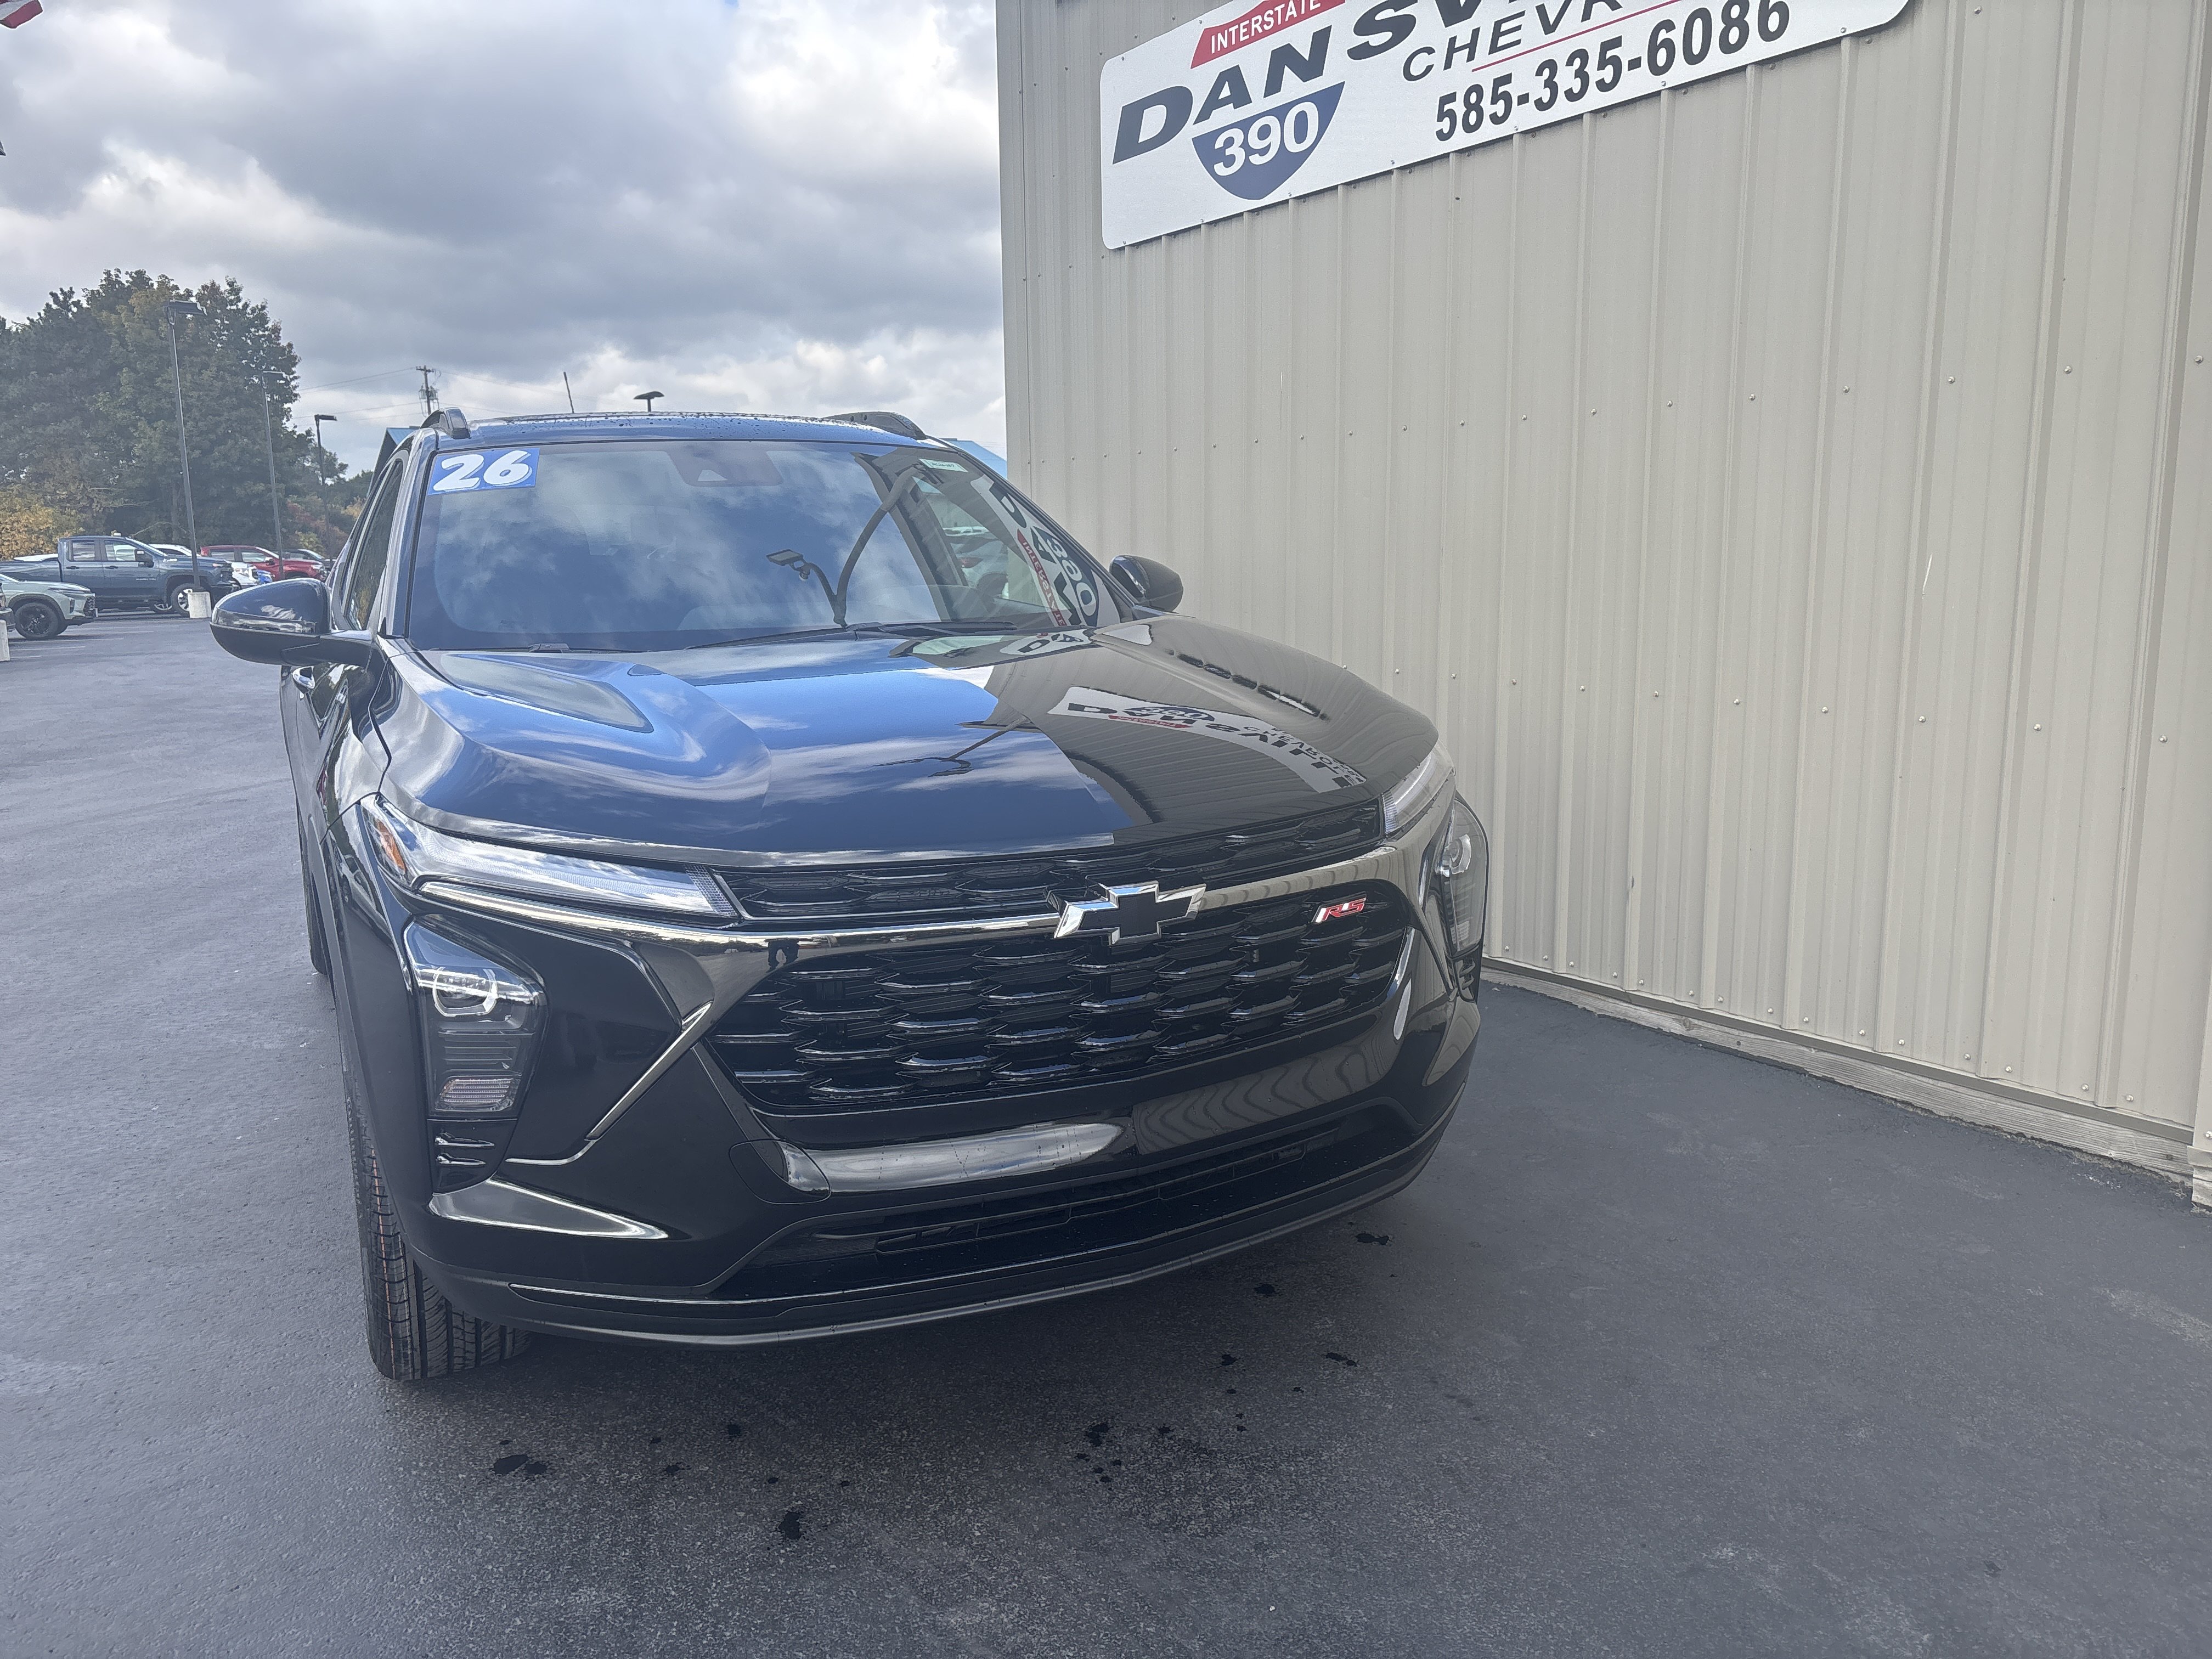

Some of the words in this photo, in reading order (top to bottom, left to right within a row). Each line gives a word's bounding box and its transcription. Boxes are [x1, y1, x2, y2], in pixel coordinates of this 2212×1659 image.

[1112, 0, 1518, 165] DANSV
[1435, 0, 1790, 142] 585-335-6086
[1213, 101, 1319, 176] 390
[433, 450, 532, 492] 26
[1315, 897, 1365, 923] RS
